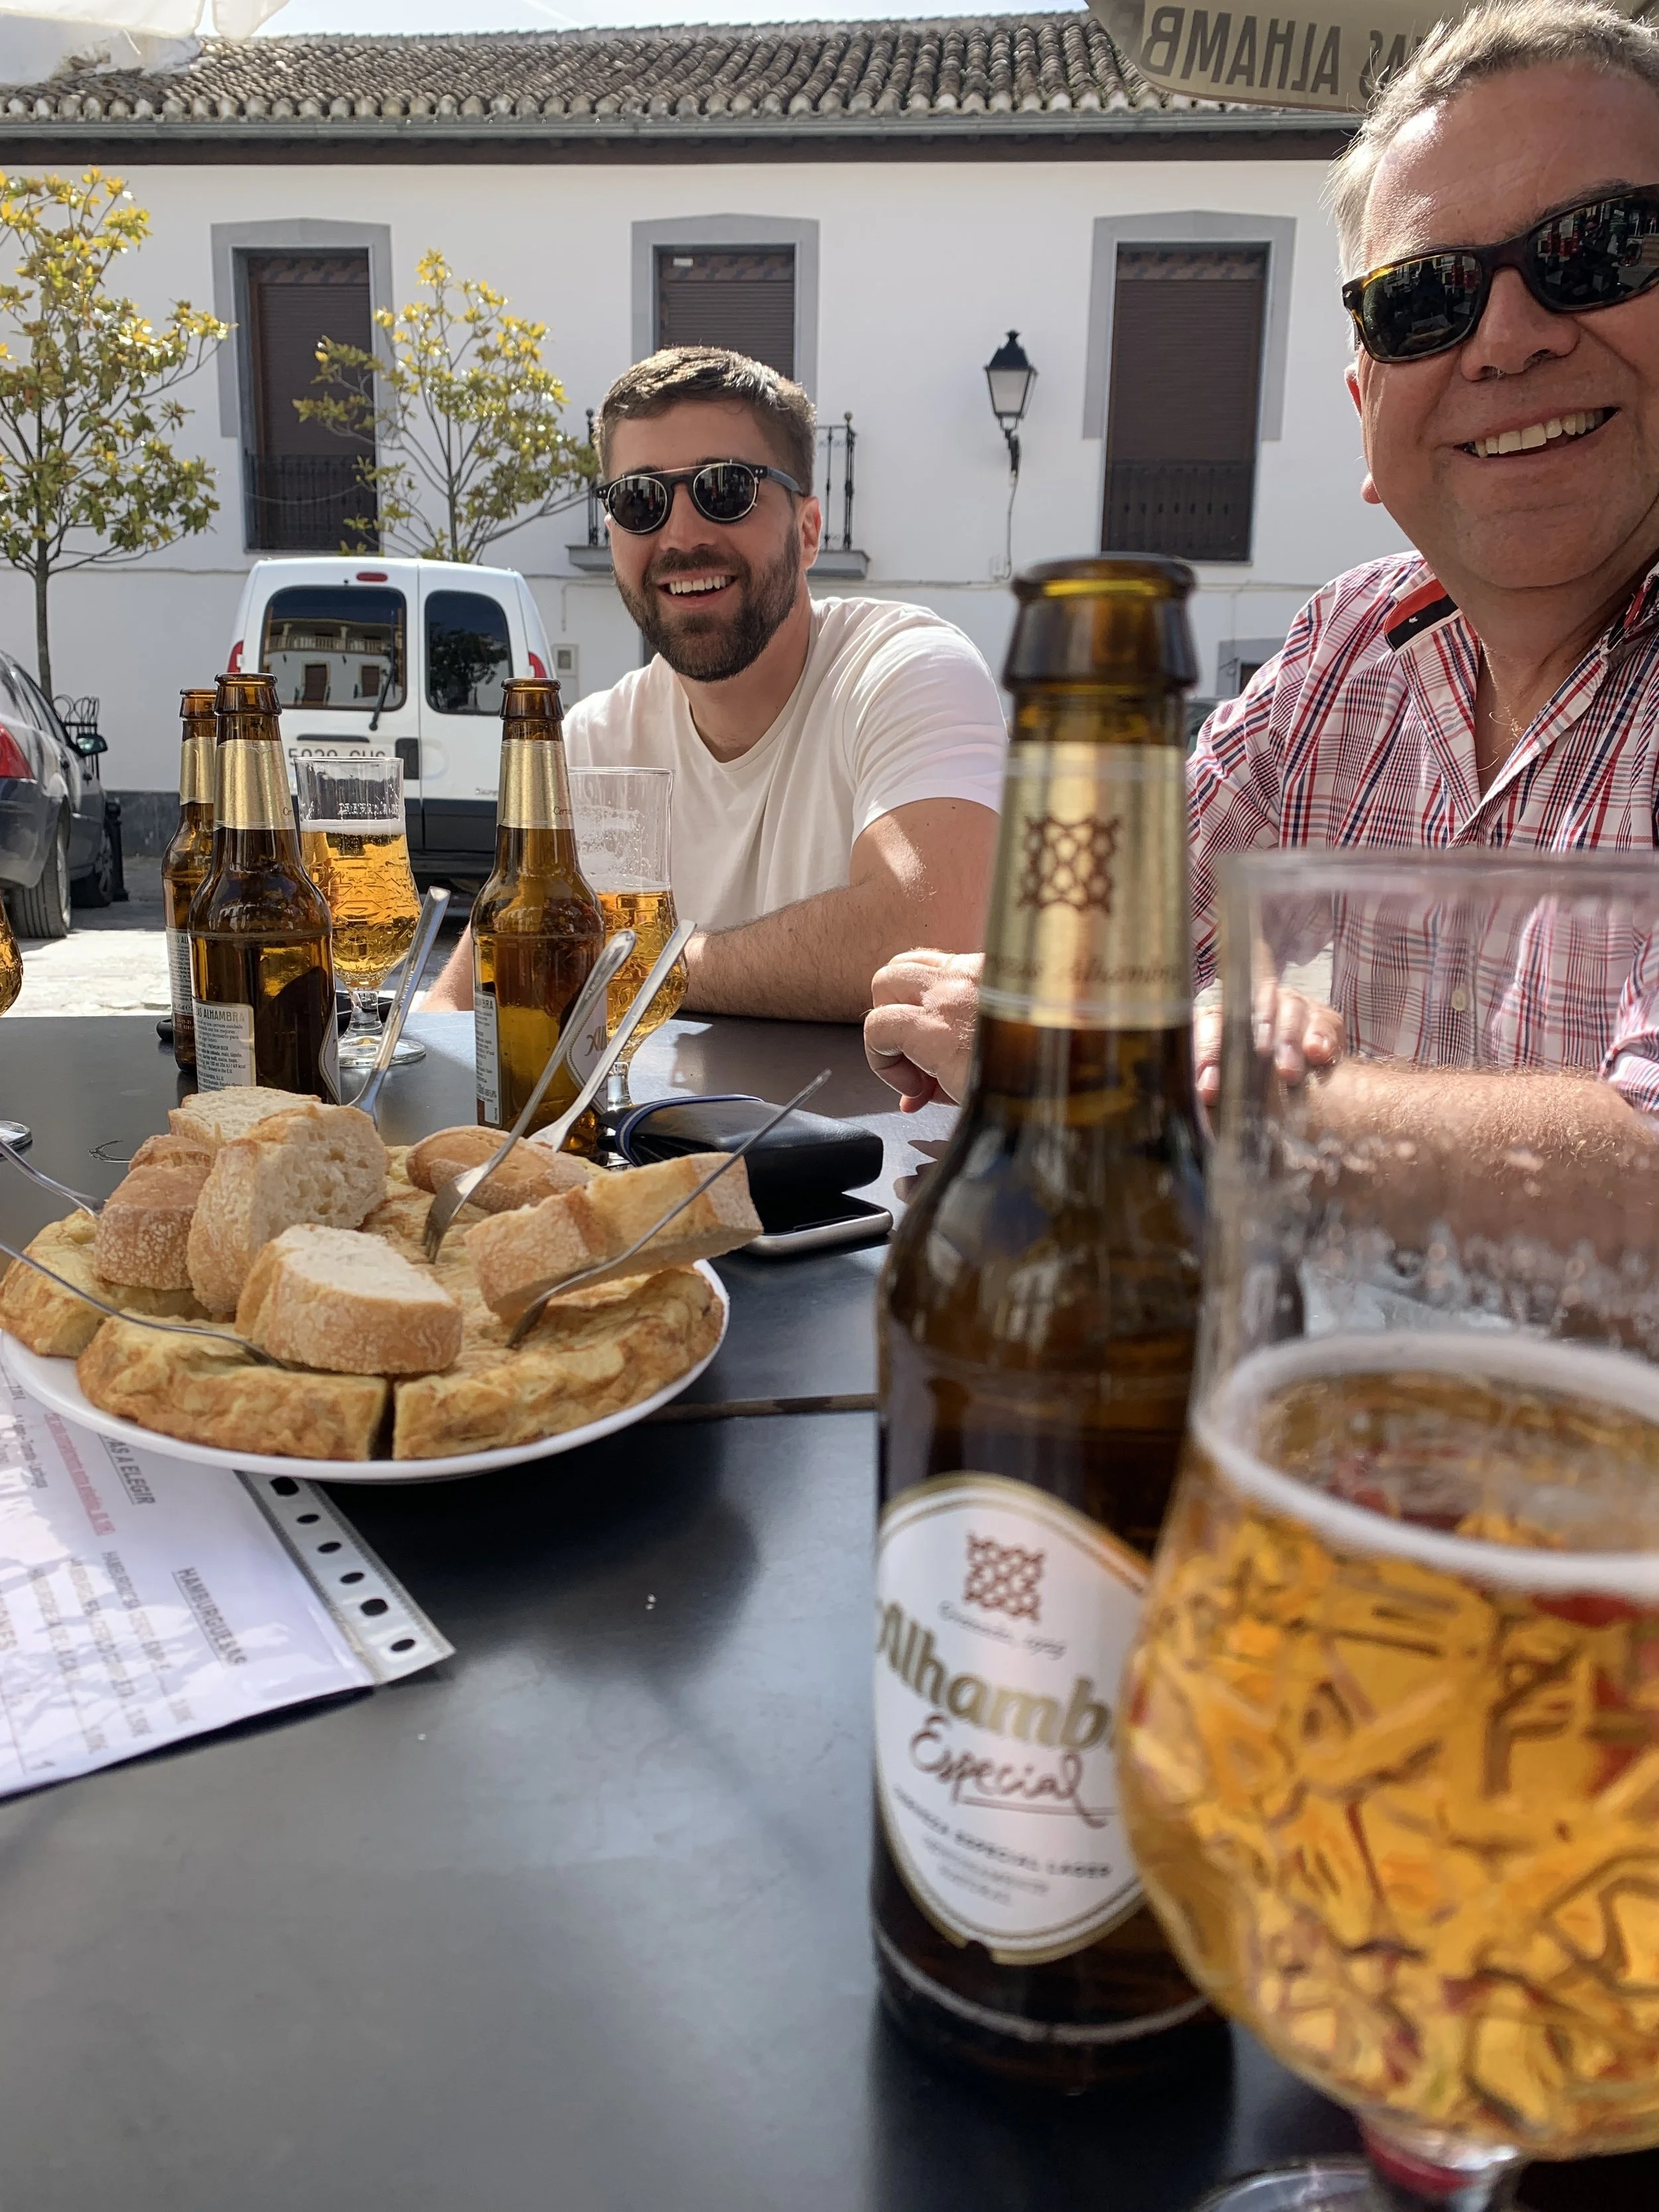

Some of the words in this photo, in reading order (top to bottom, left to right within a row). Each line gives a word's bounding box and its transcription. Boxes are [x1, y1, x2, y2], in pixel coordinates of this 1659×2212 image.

[203, 1008, 245, 1023] ALHAMBRA
[119, 1465, 157, 1505] ELEGIR
[876, 1599, 1119, 1753] Alhamb
[908, 1712, 1111, 1830] Especial
